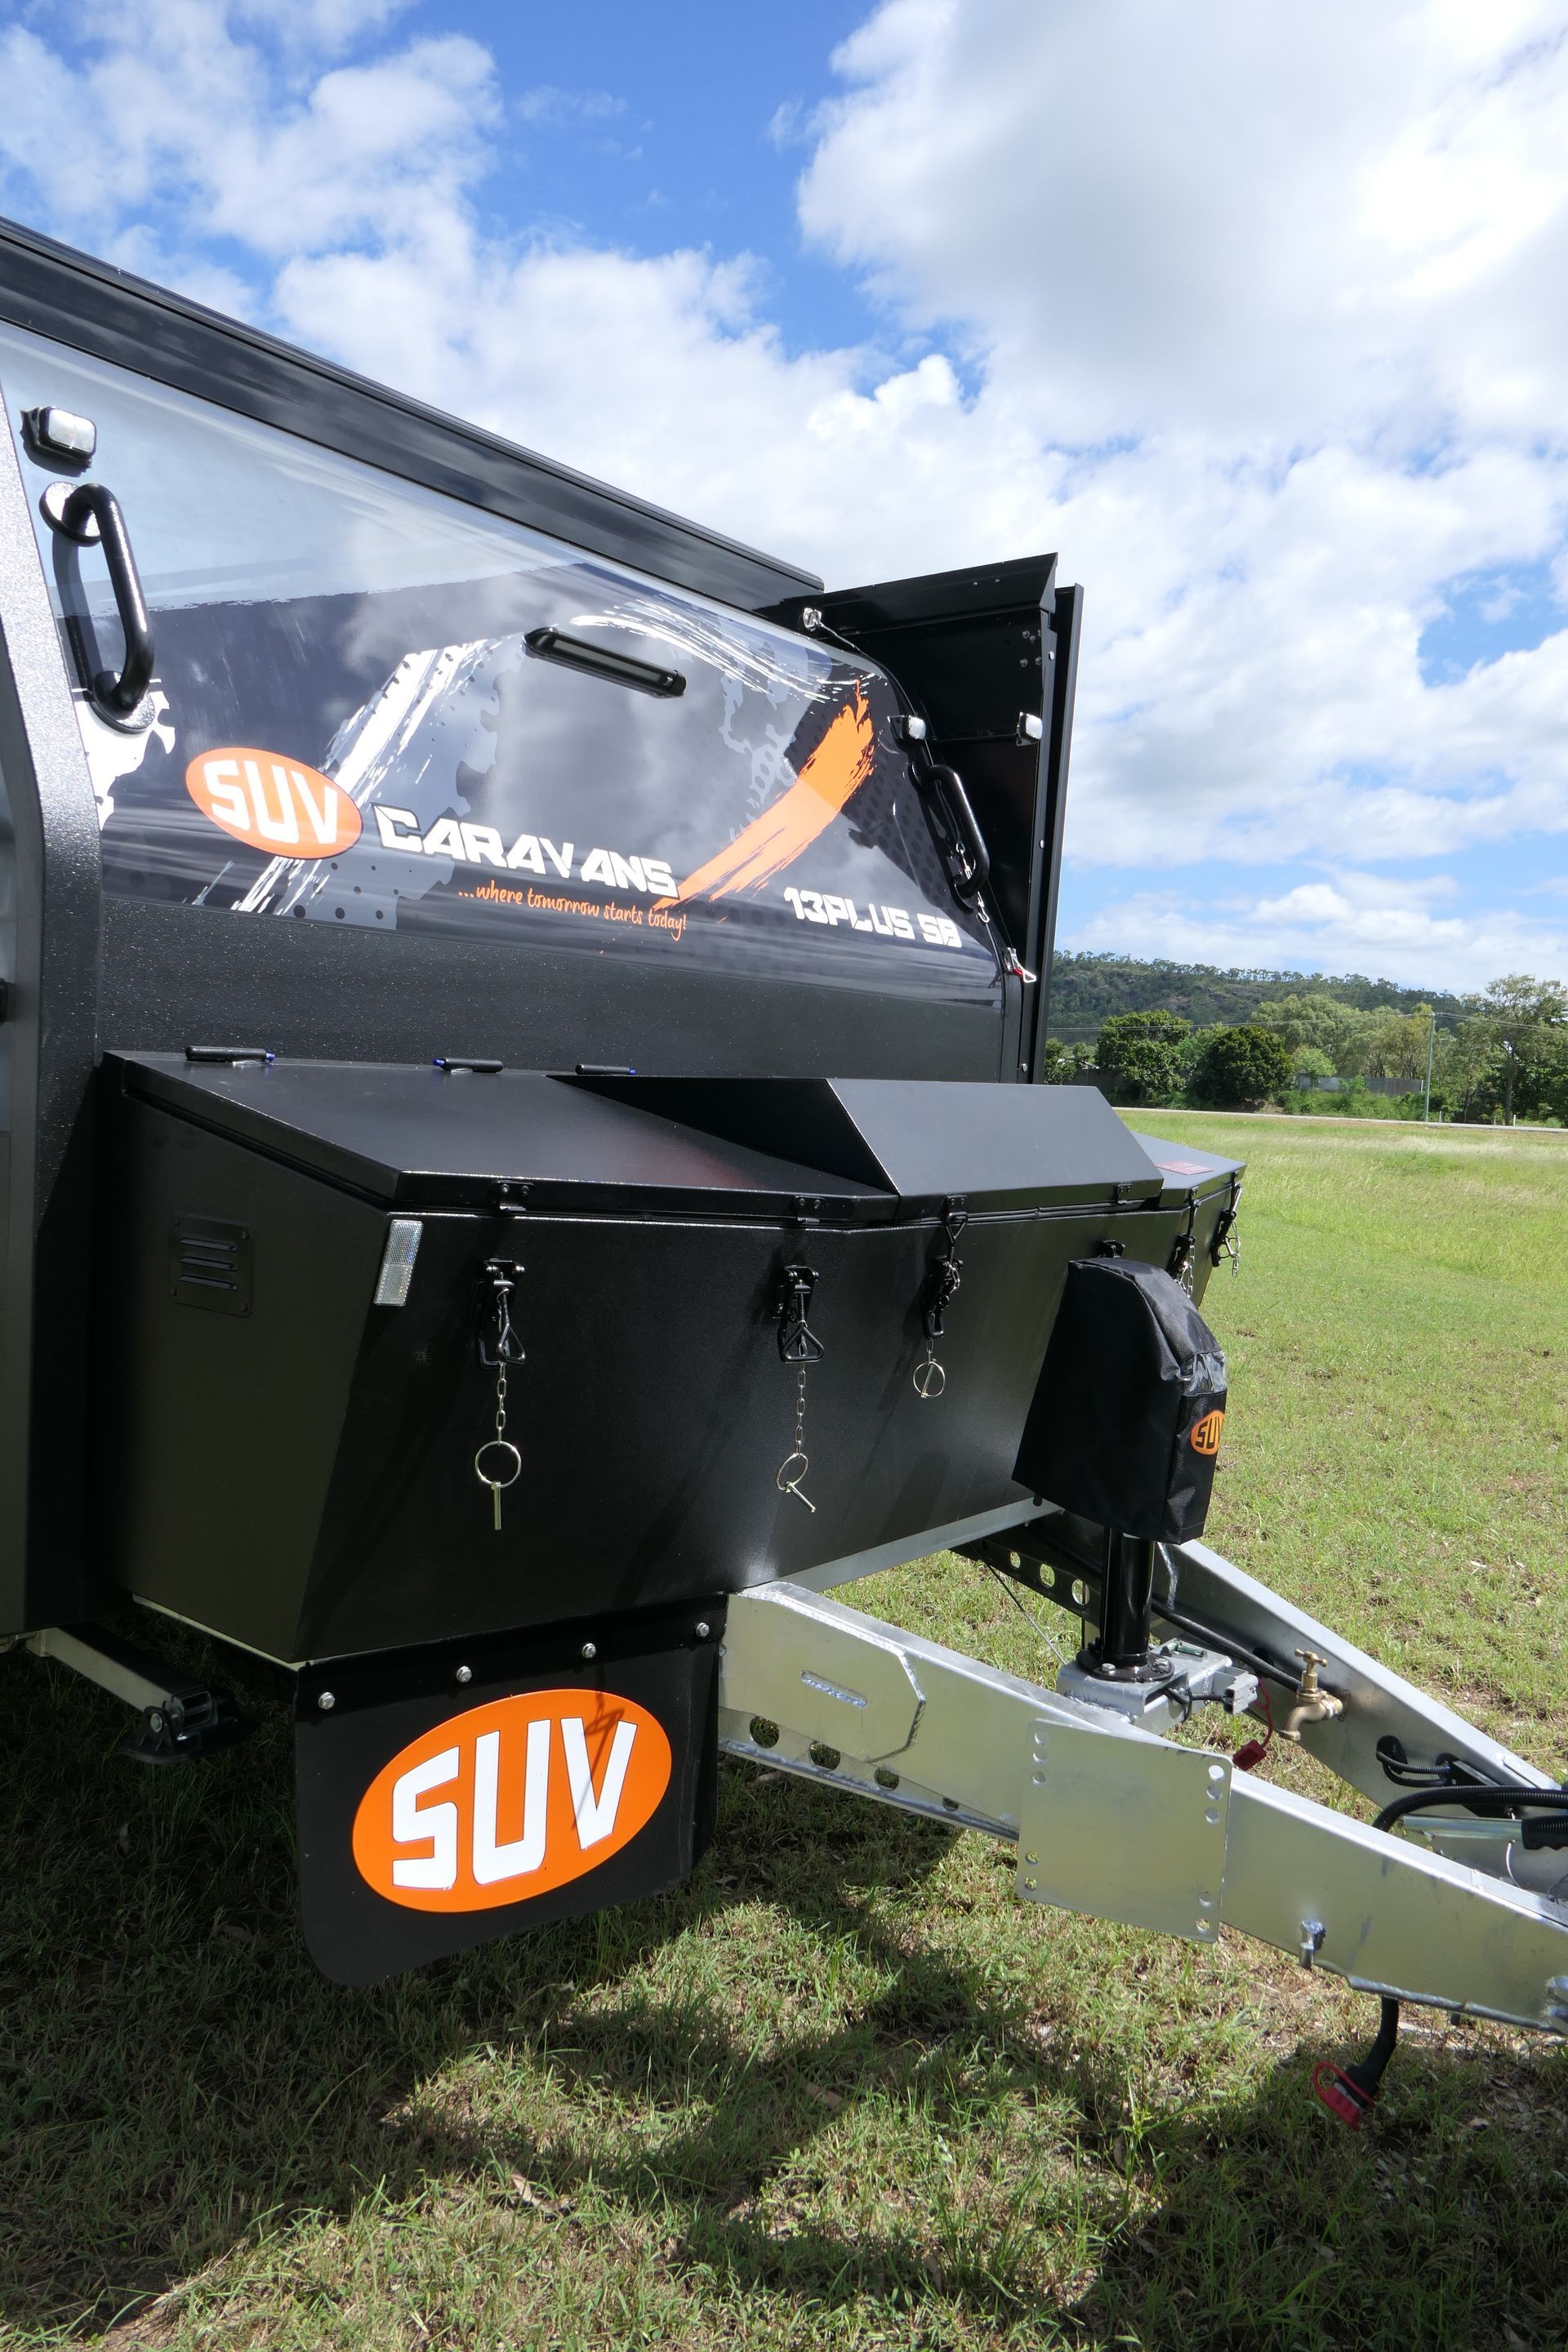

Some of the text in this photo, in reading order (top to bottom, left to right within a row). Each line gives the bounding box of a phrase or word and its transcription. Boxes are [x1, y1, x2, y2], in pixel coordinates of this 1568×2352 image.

[205, 760, 680, 898] SUV CARAVANS
[526, 887, 600, 917] tomorrow
[603, 901, 643, 925] starts
[647, 908, 687, 942] today!
[783, 887, 915, 939] 13PLUS
[392, 1717, 638, 1890] SUV
